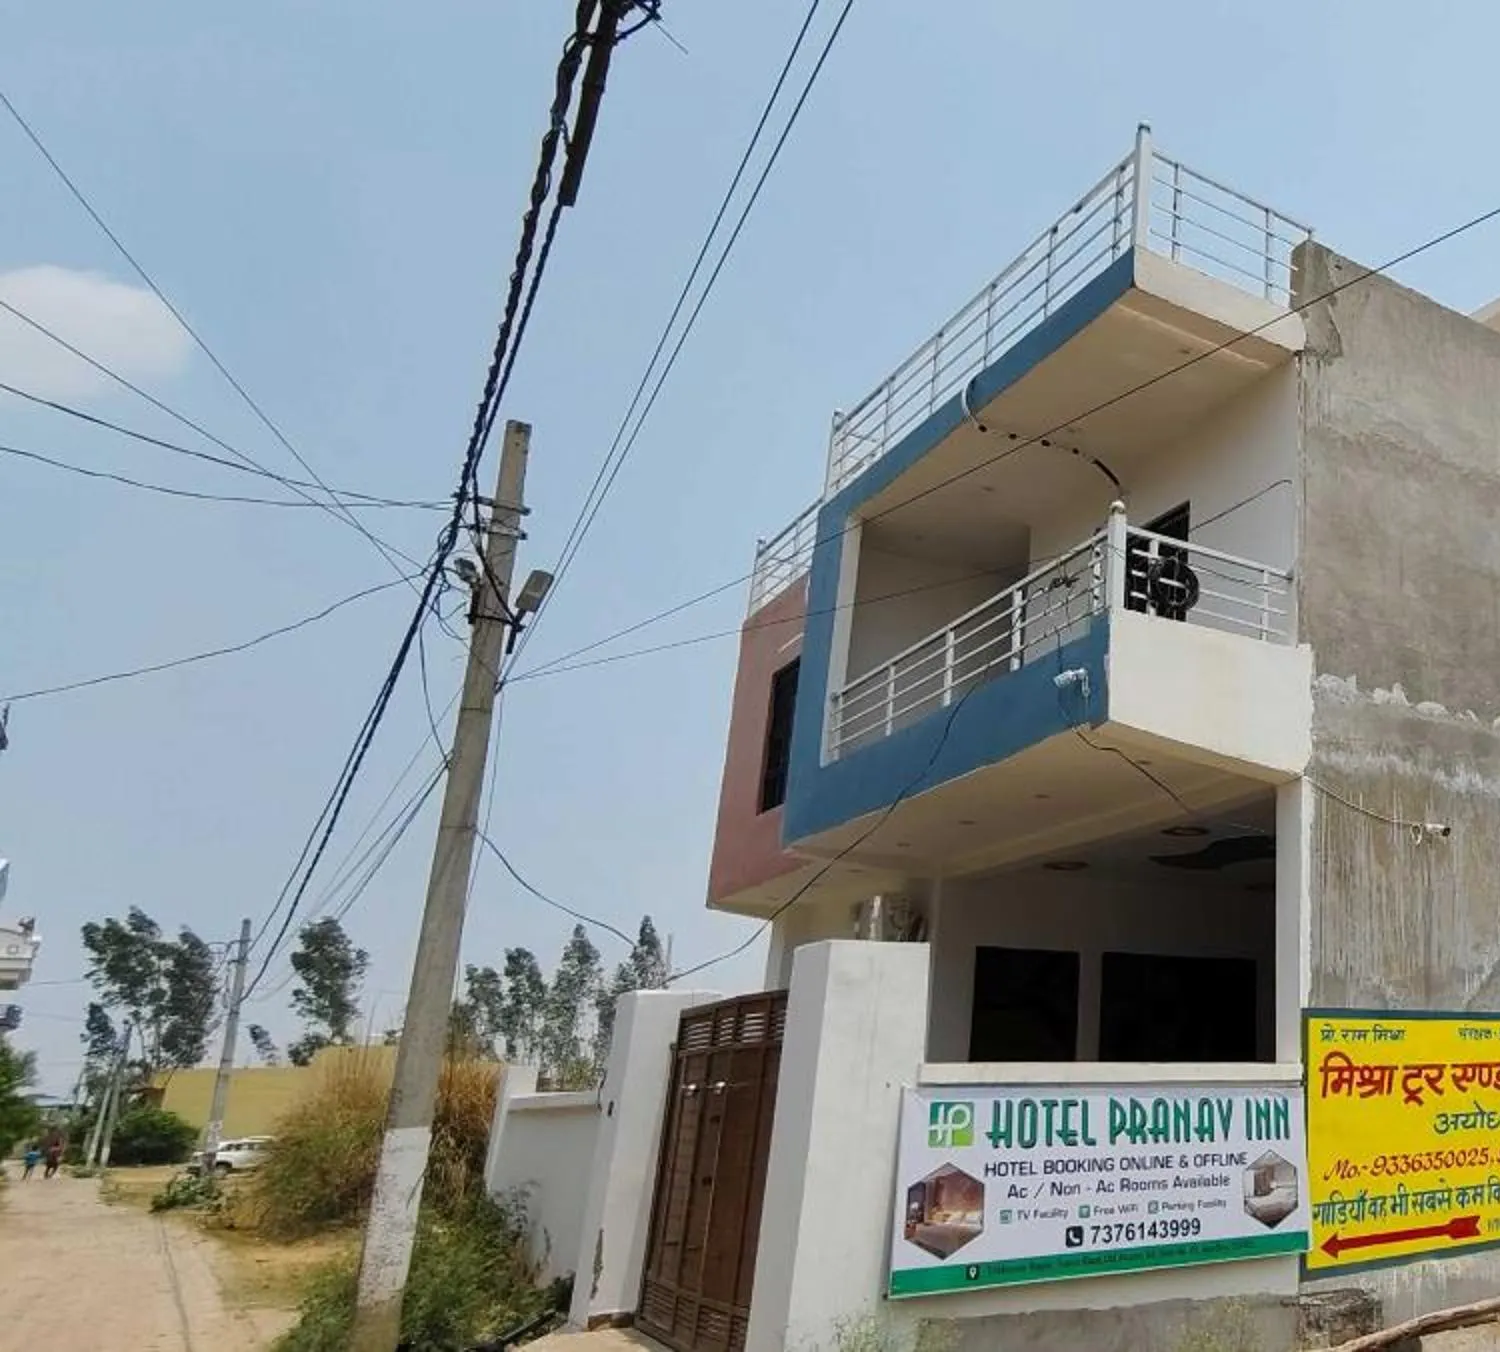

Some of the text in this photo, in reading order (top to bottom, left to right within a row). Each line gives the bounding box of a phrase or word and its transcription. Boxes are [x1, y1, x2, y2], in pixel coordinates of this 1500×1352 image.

[1318, 1050, 1398, 1098] मिश्रा
[1402, 1063, 1447, 1106] टूर
[986, 1097, 1291, 1149] HOTEL PRANAV INN
[984, 1152, 1249, 1178] HOTEL BOOKING ONLINE & OFFLINE
[1007, 1184, 1028, 1200] Ac
[1033, 1182, 1045, 1199] /
[1050, 1181, 1081, 1197] Non
[1096, 1179, 1115, 1194] Ac
[1120, 1177, 1168, 1193] Rooms
[1172, 1173, 1230, 1189] Available
[1016, 1211, 1031, 1220] TV
[1091, 1217, 1201, 1245] 7376143999
